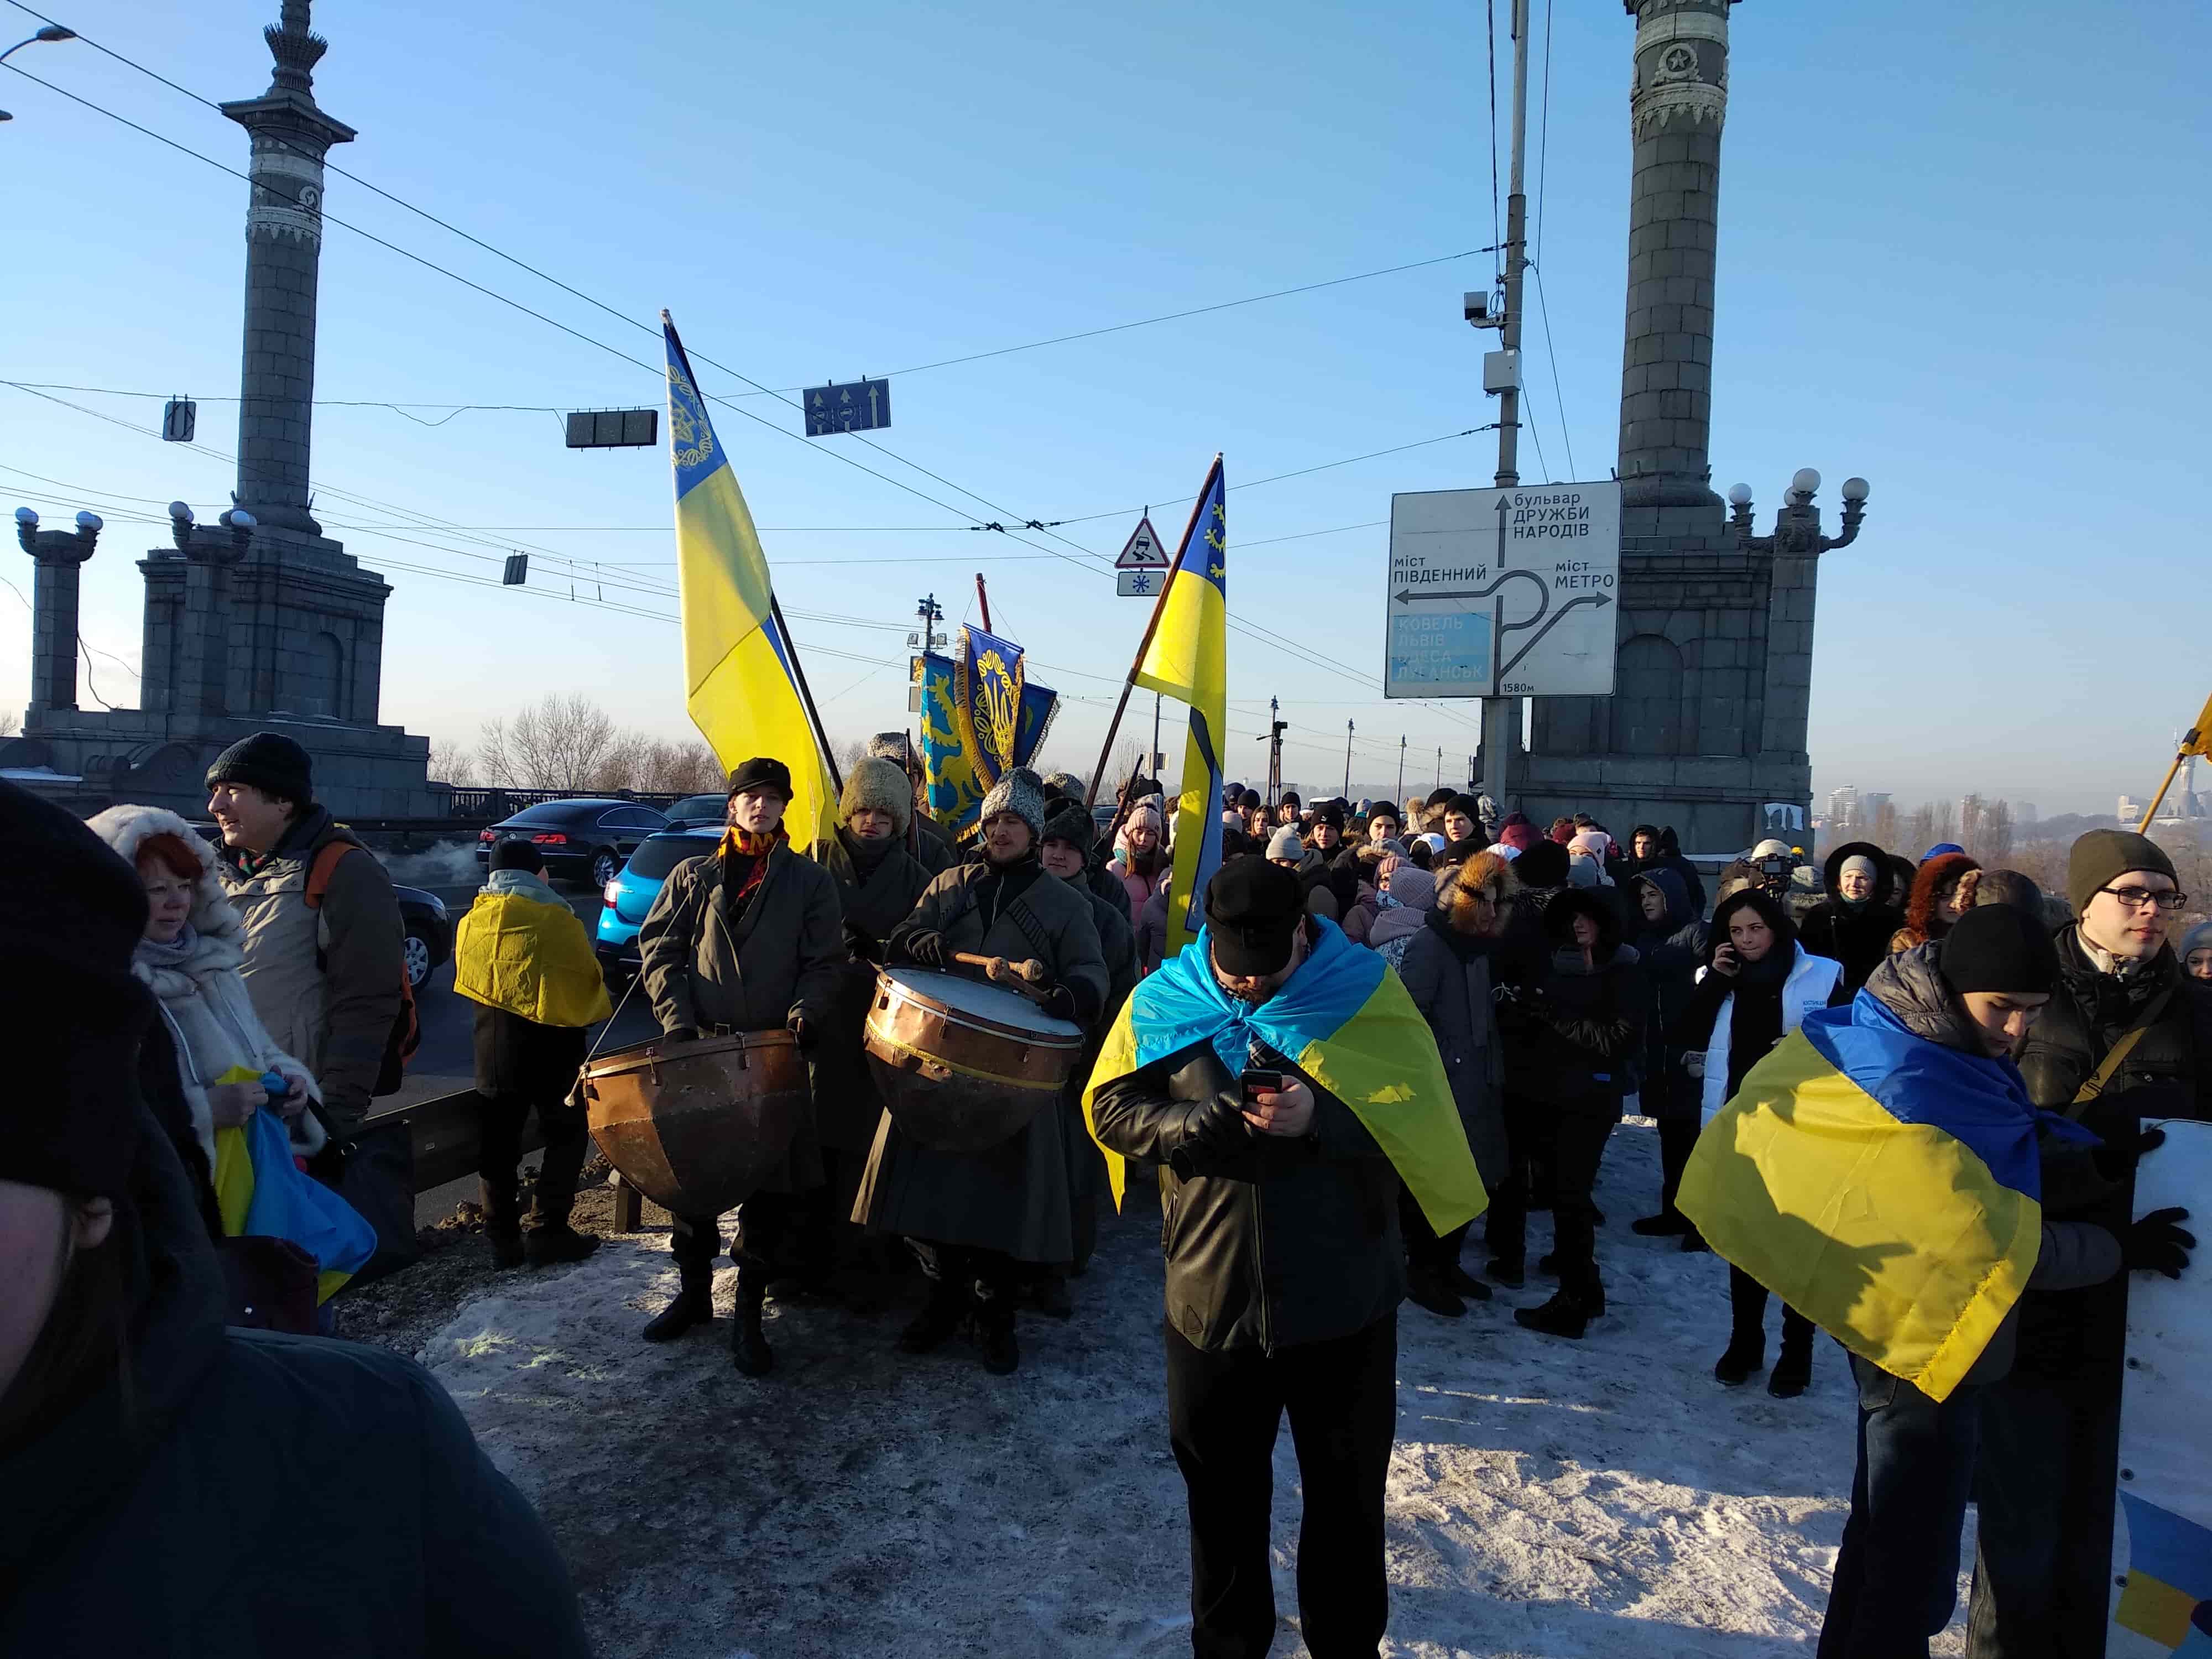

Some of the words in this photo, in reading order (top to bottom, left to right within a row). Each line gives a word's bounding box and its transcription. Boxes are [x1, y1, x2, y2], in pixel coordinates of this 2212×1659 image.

[1515, 493, 1580, 509] бульвар
[1514, 507, 1589, 524] ДРУЖБИ
[1514, 524, 1589, 539] НАРОДІВ
[1395, 555, 1425, 567] міст
[1556, 560, 1589, 572] міст
[1394, 564, 1486, 584] ПІВДЕННИЙ
[1555, 574, 1614, 588] МЕТРО
[1399, 617, 1463, 632] КОВЕЛЬ
[1398, 634, 1445, 646] ЛЬВІВ
[1504, 683, 1534, 692] 1580м
